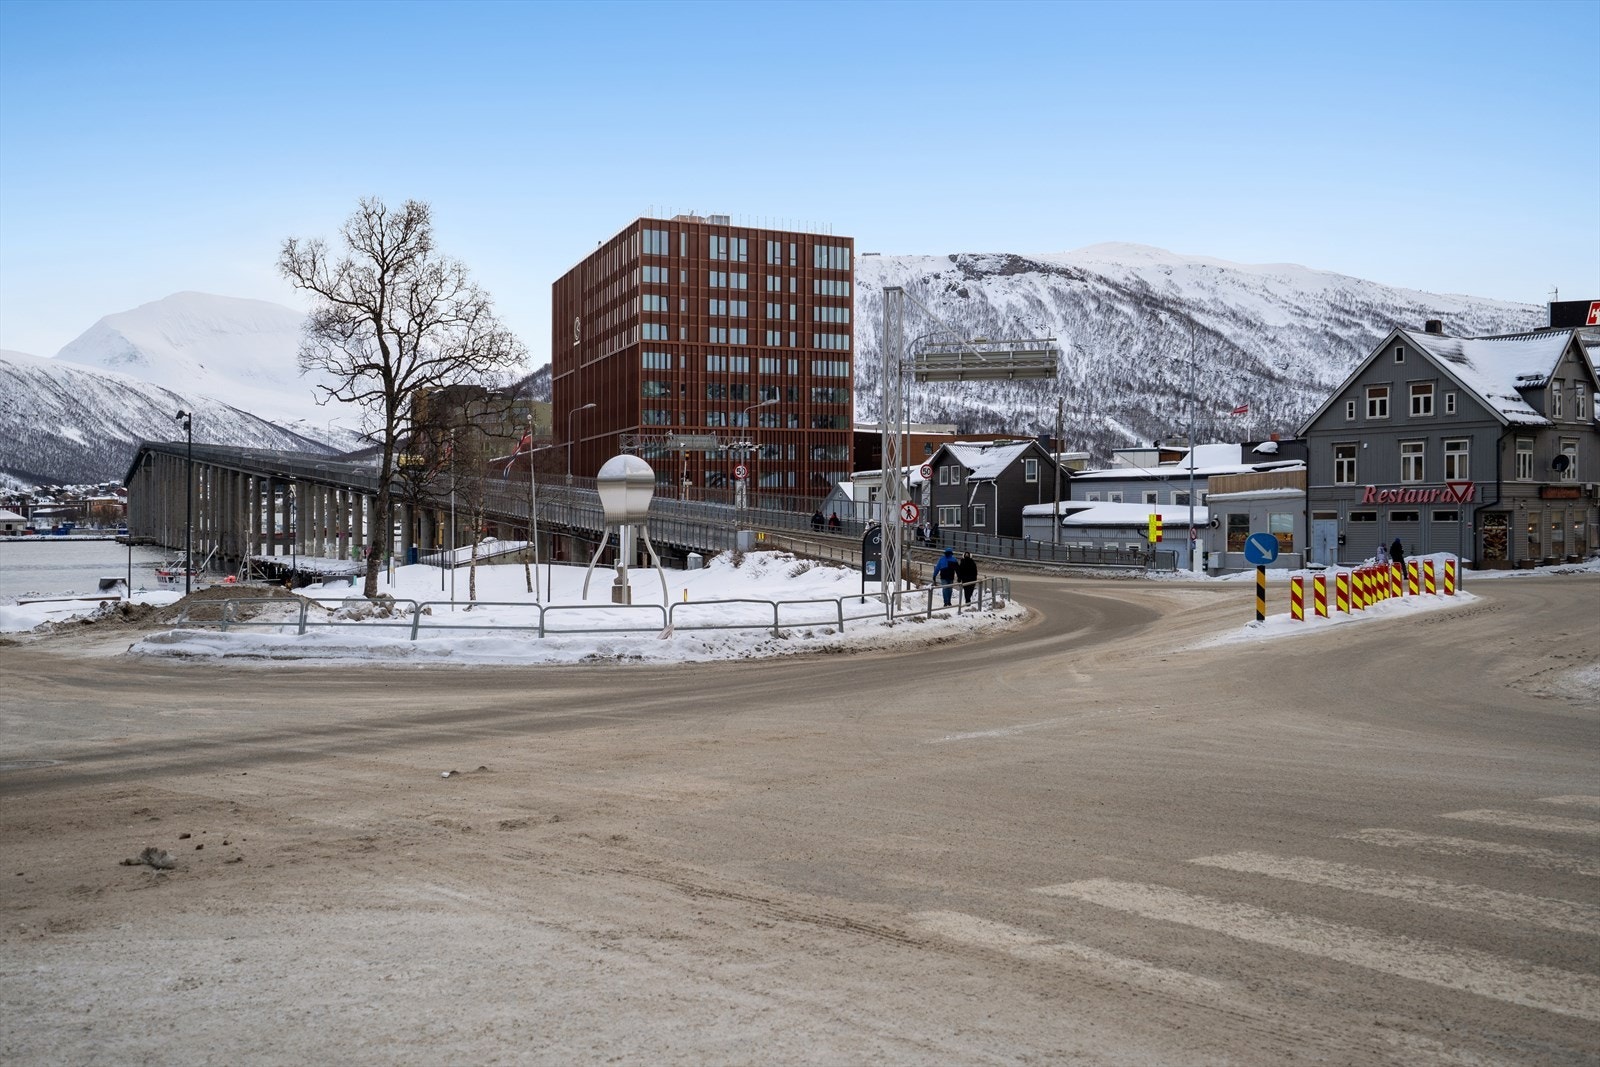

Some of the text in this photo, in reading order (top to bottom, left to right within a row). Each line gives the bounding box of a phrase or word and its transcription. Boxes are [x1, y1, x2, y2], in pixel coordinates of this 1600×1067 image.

[736, 467, 746, 476] 50
[922, 467, 931, 476] 50
[1362, 485, 1476, 504] Restaurat
